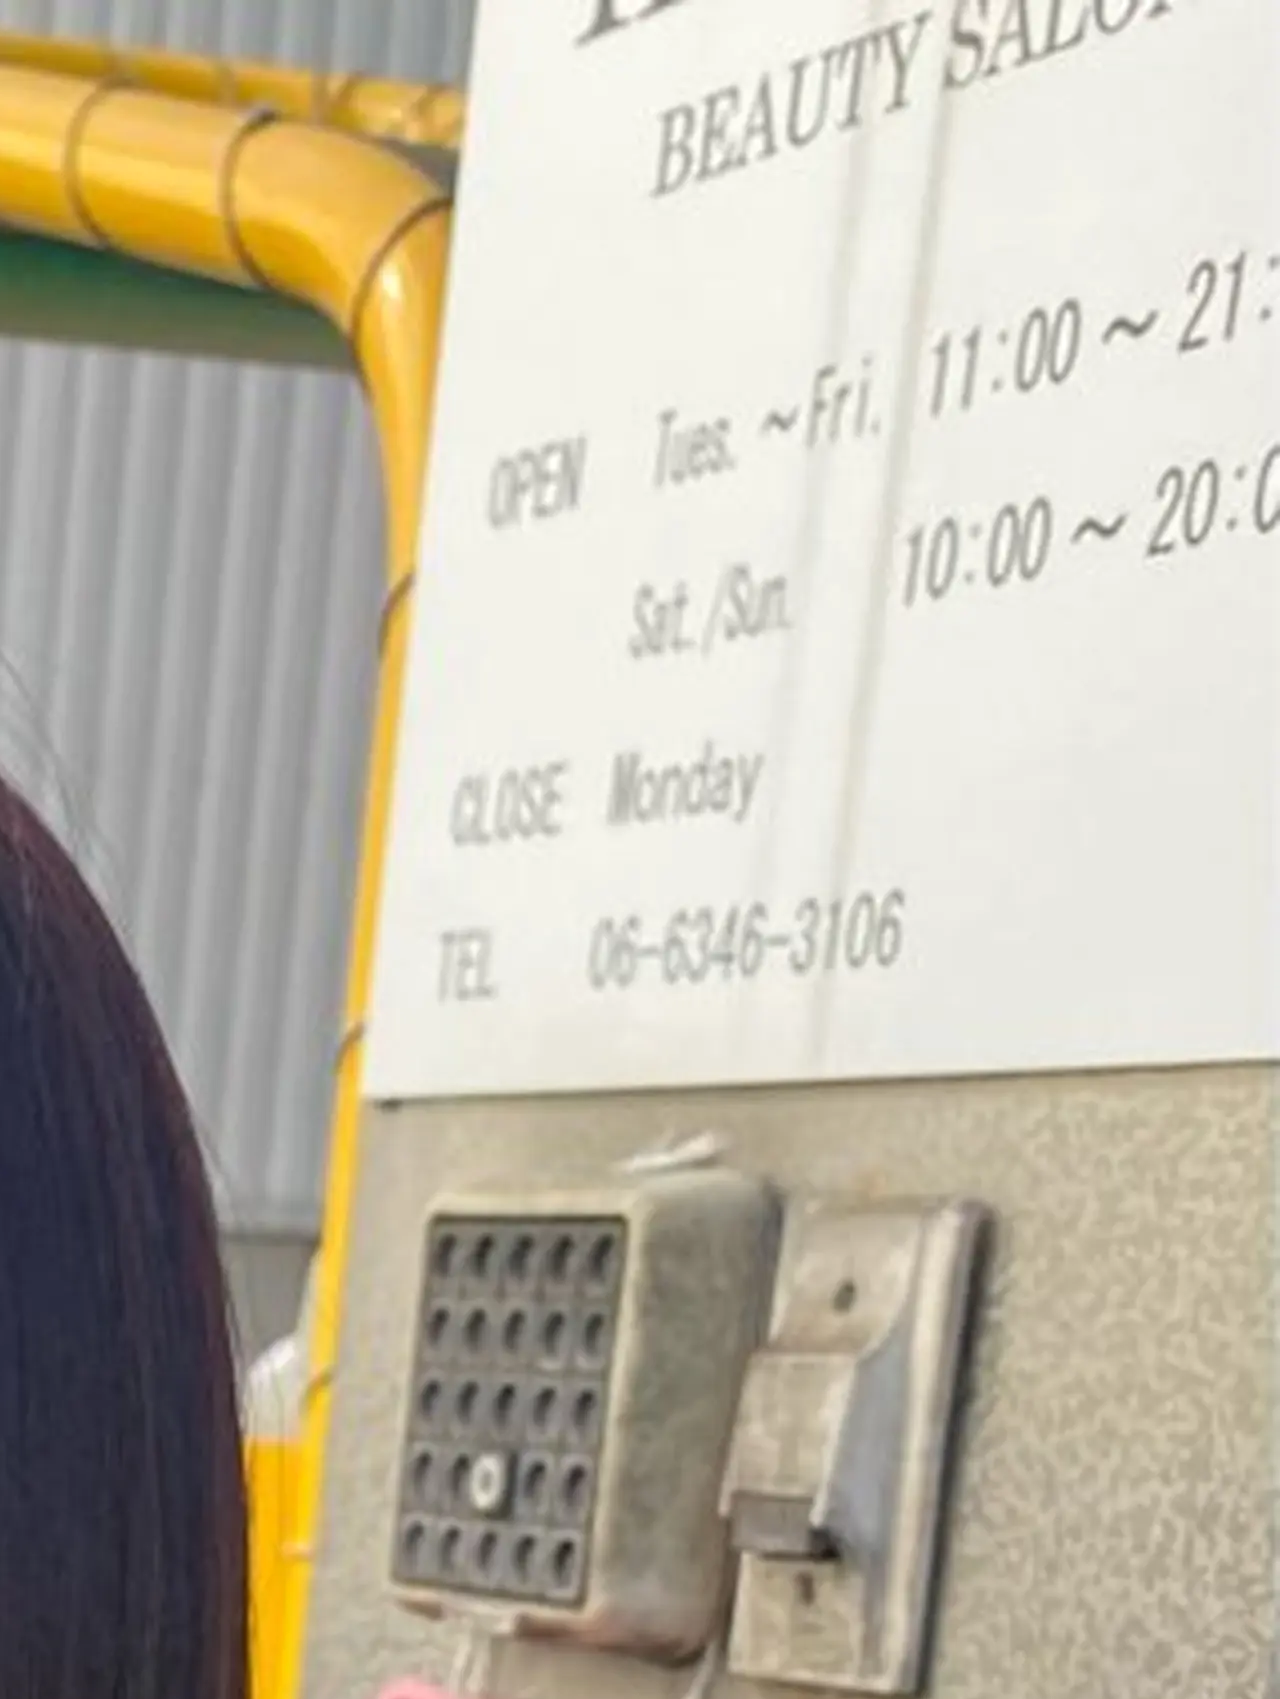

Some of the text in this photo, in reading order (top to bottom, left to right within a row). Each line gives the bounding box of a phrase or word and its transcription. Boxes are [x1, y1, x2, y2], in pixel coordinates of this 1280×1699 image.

[648, 8, 934, 199] BEAUTY
[488, 433, 588, 530] OPEN
[929, 296, 1082, 421] 11:00
[900, 495, 1054, 610] 10:00
[449, 737, 766, 848] CLOSE Monday
[438, 887, 907, 1003] TEL 06-6346-3106
